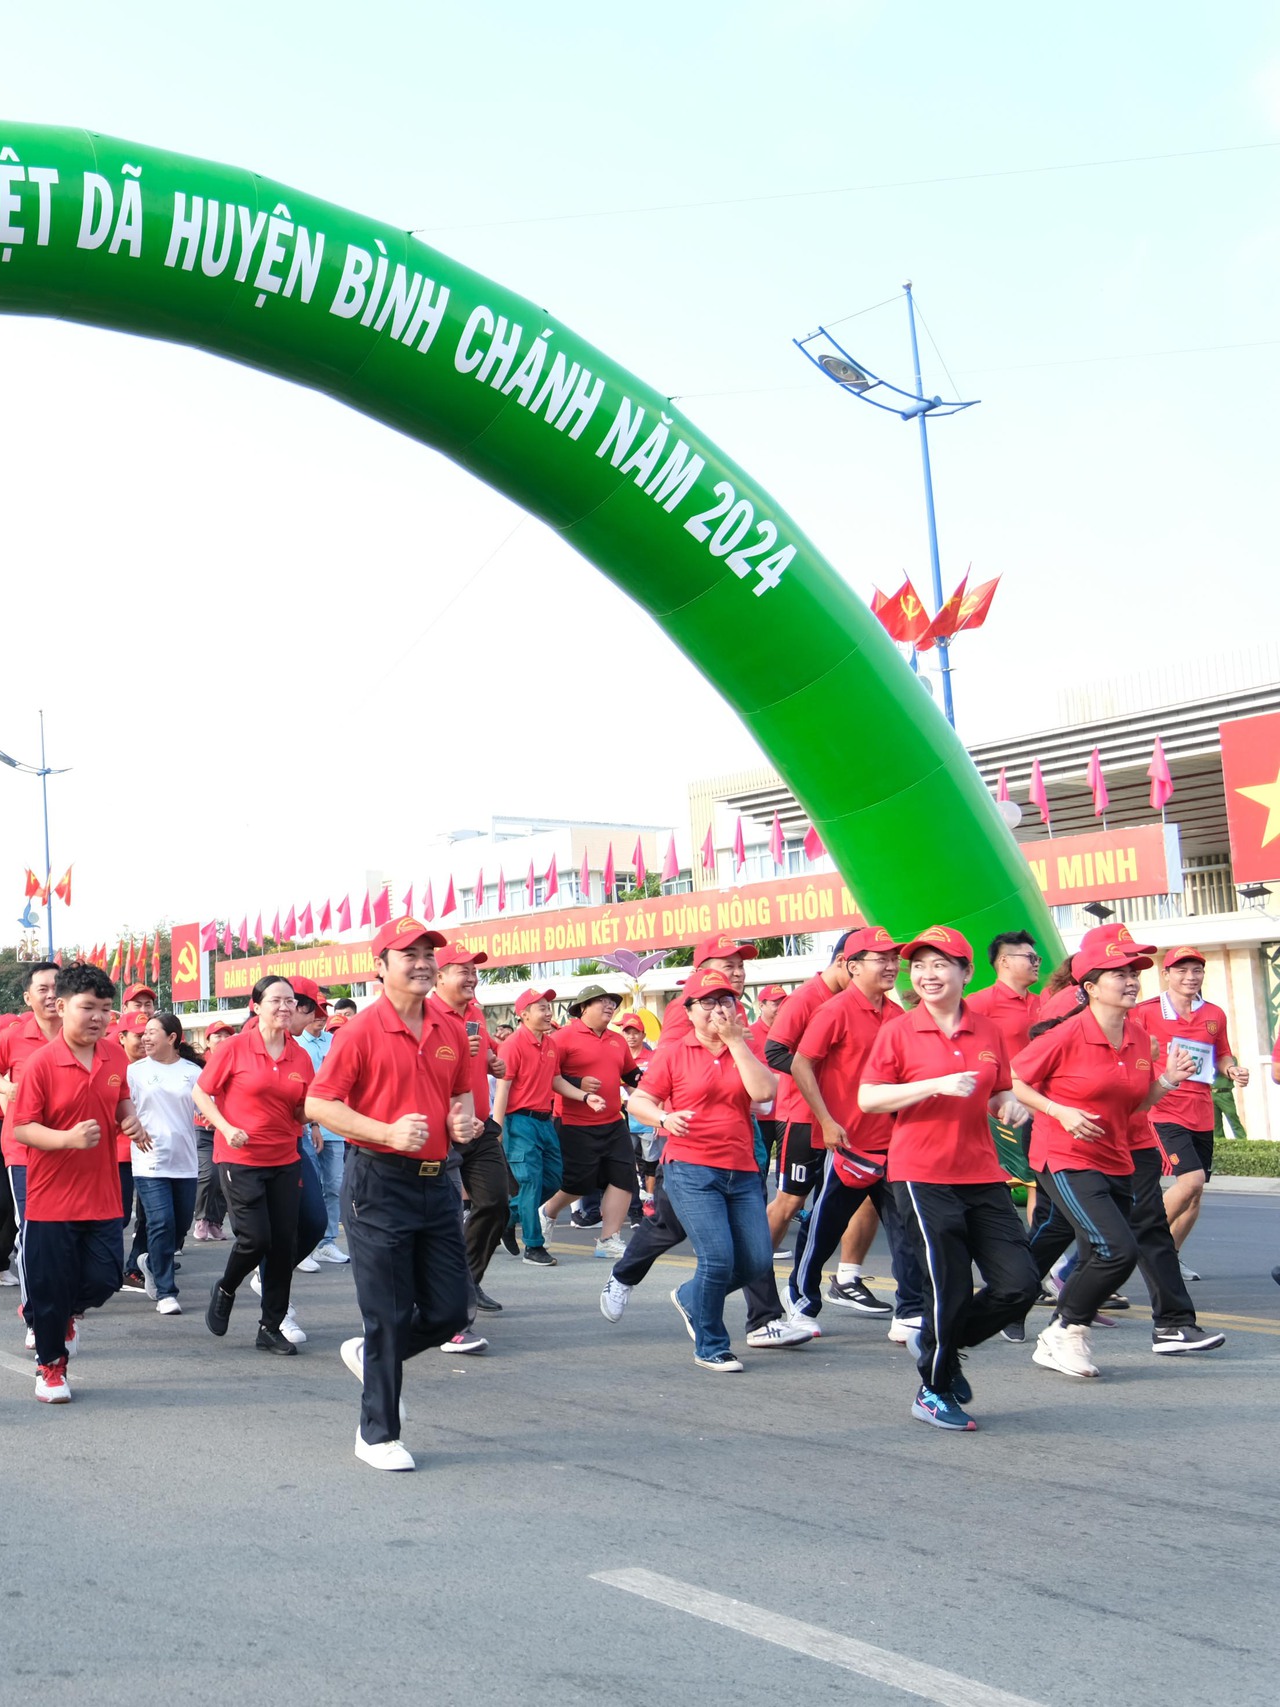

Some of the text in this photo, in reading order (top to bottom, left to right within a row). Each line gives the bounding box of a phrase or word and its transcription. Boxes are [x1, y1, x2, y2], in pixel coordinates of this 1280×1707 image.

[77, 163, 142, 258] DÃ
[164, 192, 325, 308] HUYỆN
[329, 239, 450, 354] BÌNH
[454, 305, 606, 441] CHÁNH
[595, 396, 706, 513] NĂM
[683, 481, 797, 597] 2024
[335, 950, 349, 976] VÀ
[492, 928, 541, 957] CHÁNH
[544, 918, 587, 951] ĐOÀN
[591, 910, 620, 944] KẾT
[625, 908, 657, 941] XÂY
[662, 904, 712, 941] DỰNG
[716, 894, 771, 930] NÔNG
[776, 884, 834, 922] THÔN
[1057, 847, 1138, 889] MINH
[791, 1163, 807, 1182] 10
